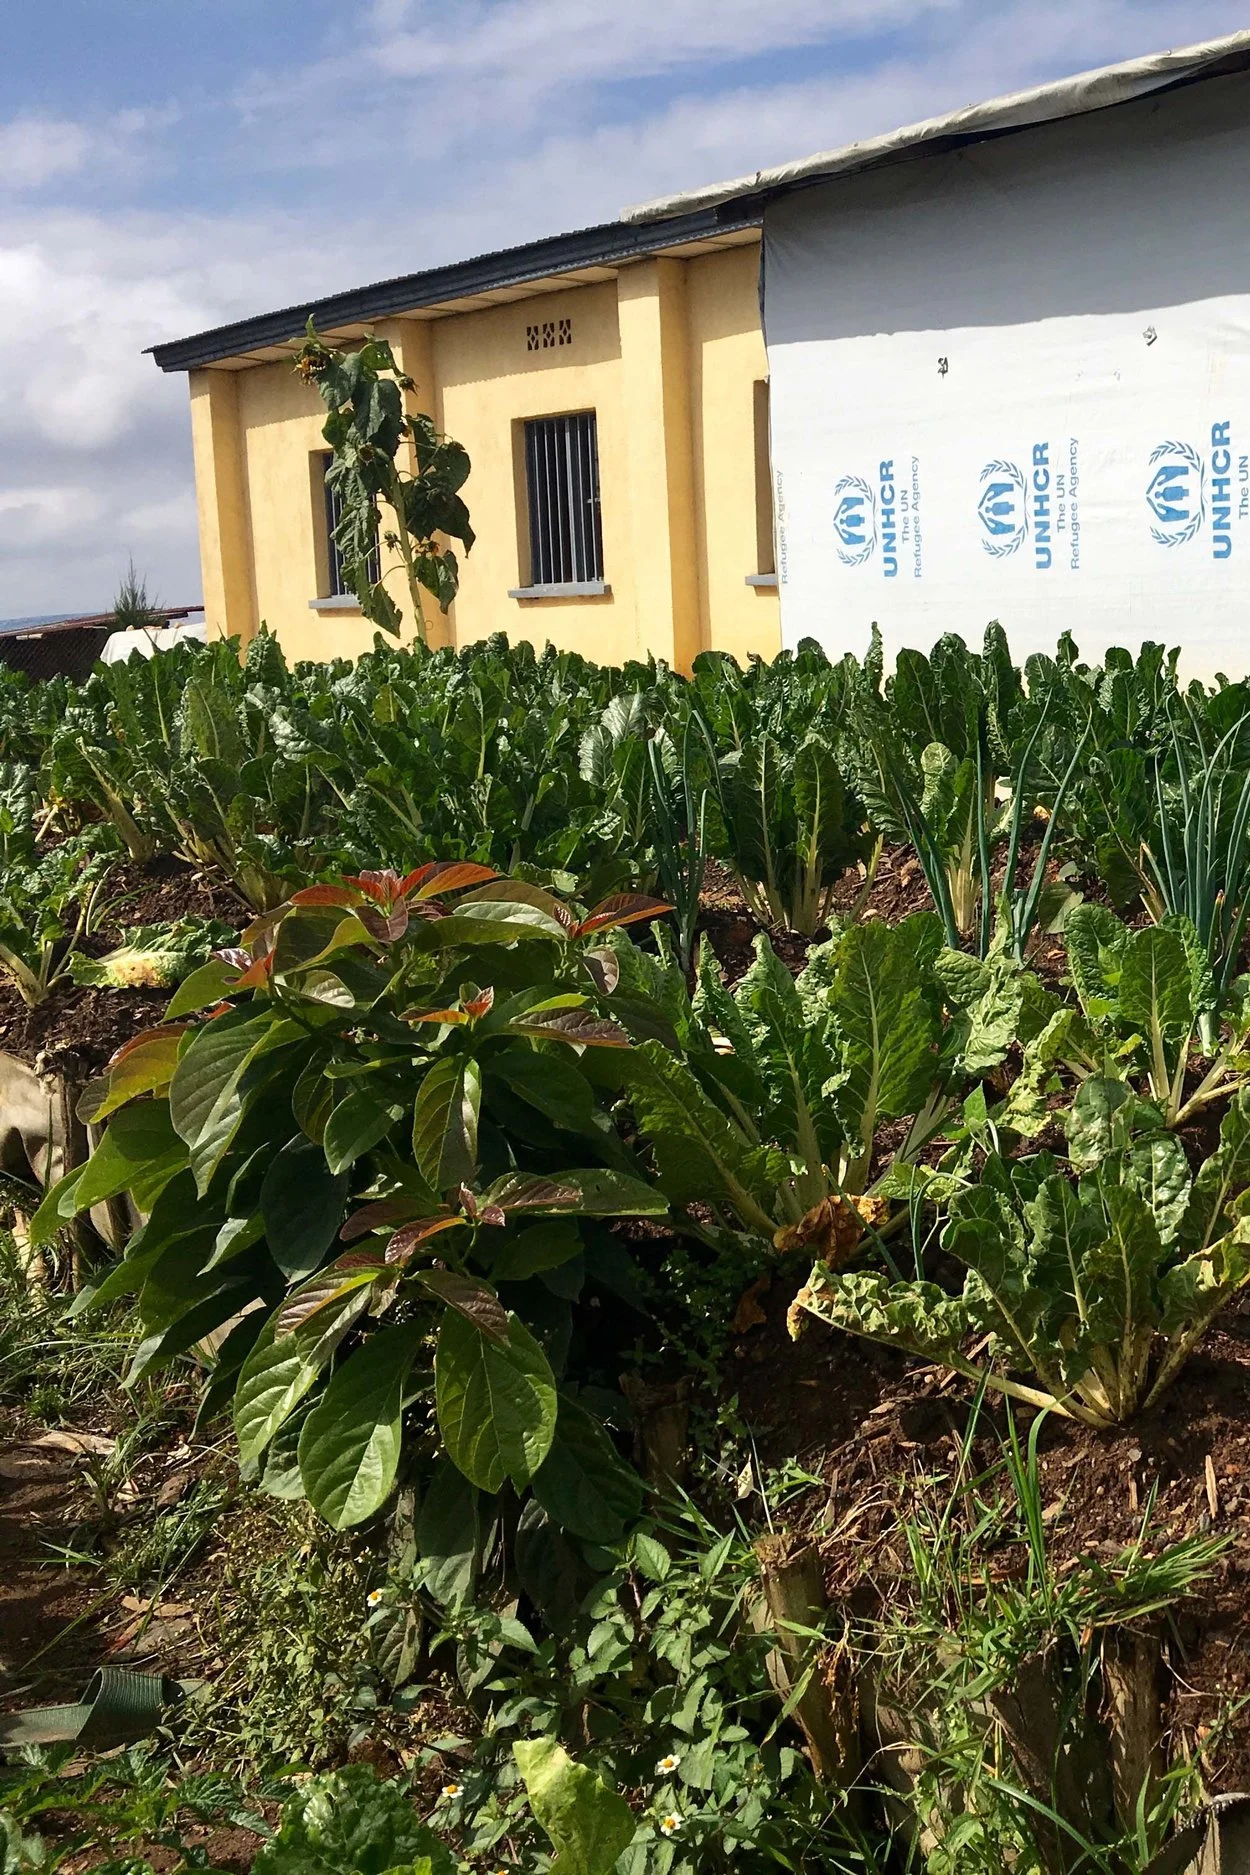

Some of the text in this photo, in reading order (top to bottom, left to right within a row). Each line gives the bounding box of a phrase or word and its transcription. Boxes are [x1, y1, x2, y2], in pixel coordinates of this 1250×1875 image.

[777, 470, 785, 522] Agency
[880, 460, 897, 577] UNHCR
[900, 490, 908, 512] UN
[911, 456, 922, 577] Refugee Agency
[1033, 442, 1051, 569] UNHCR
[1056, 475, 1065, 533] The UN
[1069, 438, 1080, 569] Refugee Agency
[1212, 421, 1232, 559] UNHCR
[1239, 456, 1249, 519] The UN
